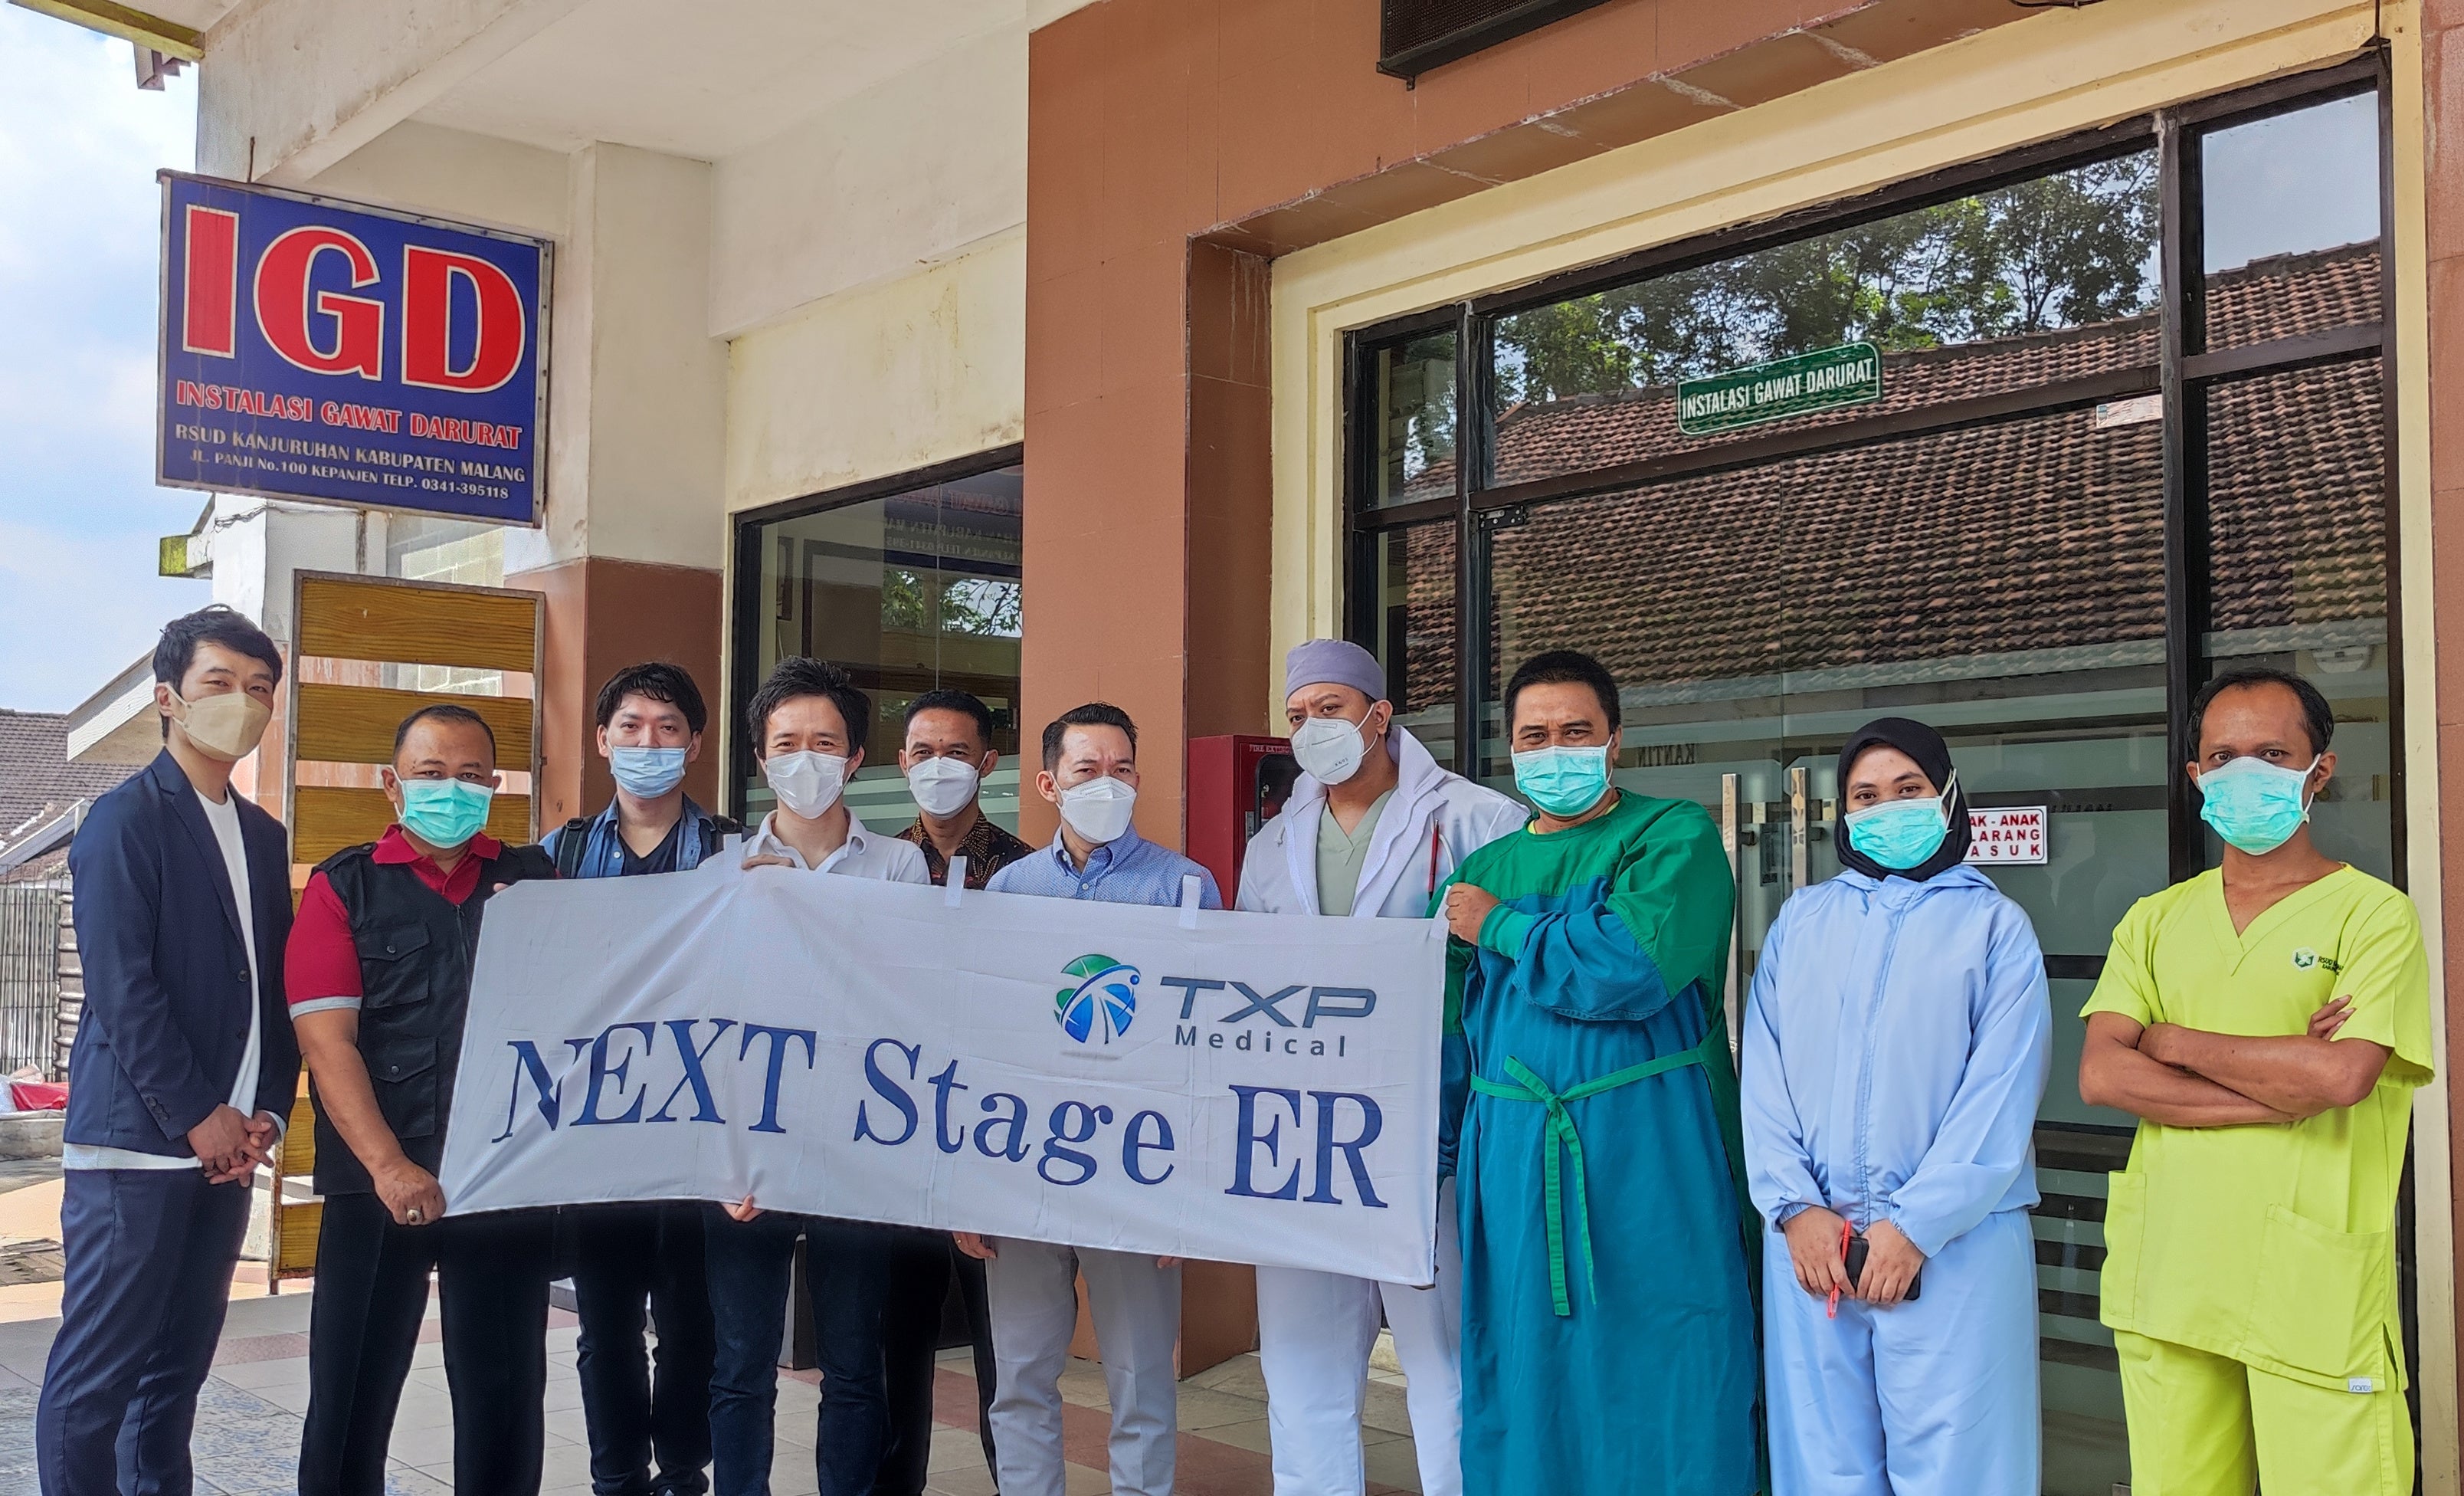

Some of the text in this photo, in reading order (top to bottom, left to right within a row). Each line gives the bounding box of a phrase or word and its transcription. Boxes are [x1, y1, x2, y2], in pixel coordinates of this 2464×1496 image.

[183, 204, 526, 393] IGD
[1682, 357, 1874, 419] INSTALASI GAWAT DARURAT
[177, 379, 523, 450] INSTALASI GAWAT DARURAT
[175, 424, 526, 483] RSUD KANJURUHAN KABUPATEN MALANG
[215, 452, 254, 468] PANJI
[257, 458, 307, 475] No.100
[311, 464, 378, 484] KEPANJEN
[382, 473, 418, 488] TELP.
[421, 477, 510, 499] 0341-395118
[1249, 744, 1265, 753] FIRE
[1970, 815, 1987, 827] AK
[2000, 814, 2040, 827] ANAK
[1971, 828, 2040, 842] ARANG
[1970, 844, 2040, 858] ASUK
[1160, 976, 1378, 1028] TXP
[1174, 1025, 1345, 1058] Medical
[491, 1017, 1389, 1209] NEXT Stage ER
